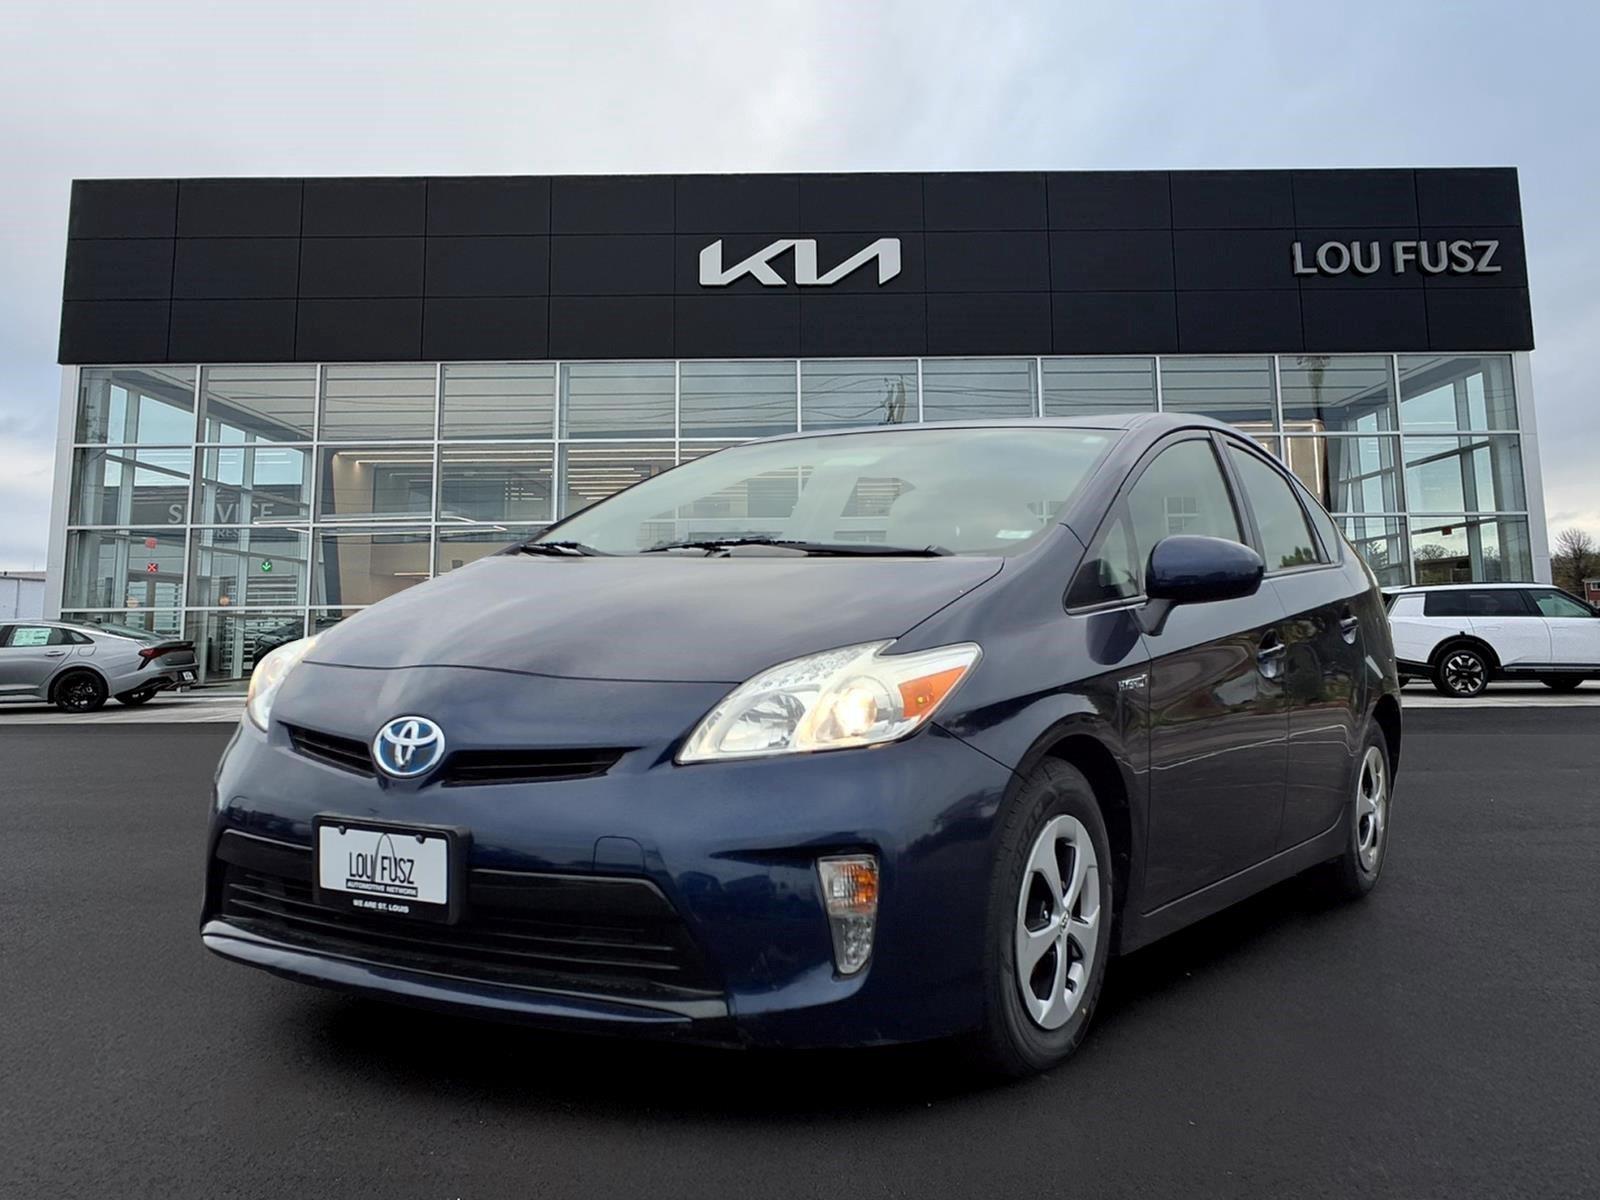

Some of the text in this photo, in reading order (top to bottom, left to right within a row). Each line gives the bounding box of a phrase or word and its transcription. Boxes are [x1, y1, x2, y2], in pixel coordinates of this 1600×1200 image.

[699, 238, 902, 286] KIA
[1292, 240, 1502, 275] LOU FUSZ
[350, 852, 414, 884] LOU FUSZ
